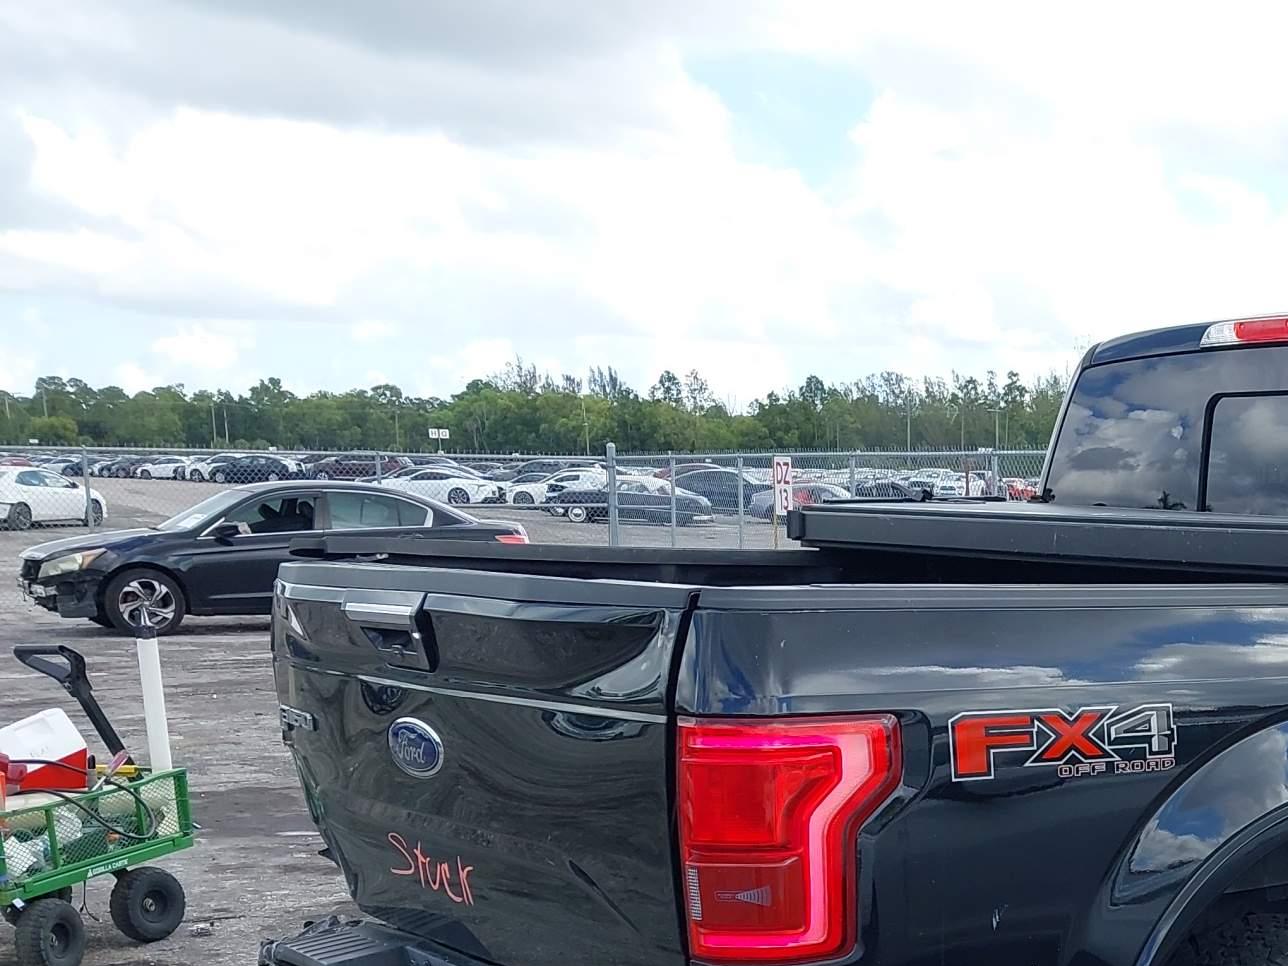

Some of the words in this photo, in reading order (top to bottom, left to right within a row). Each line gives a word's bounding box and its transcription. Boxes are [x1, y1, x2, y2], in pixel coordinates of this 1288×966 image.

[776, 461, 790, 485] DZ
[780, 487, 789, 510] 13
[948, 703, 1177, 781] FX4
[1058, 762, 1105, 777] OFF
[1115, 758, 1176, 773] ROAD
